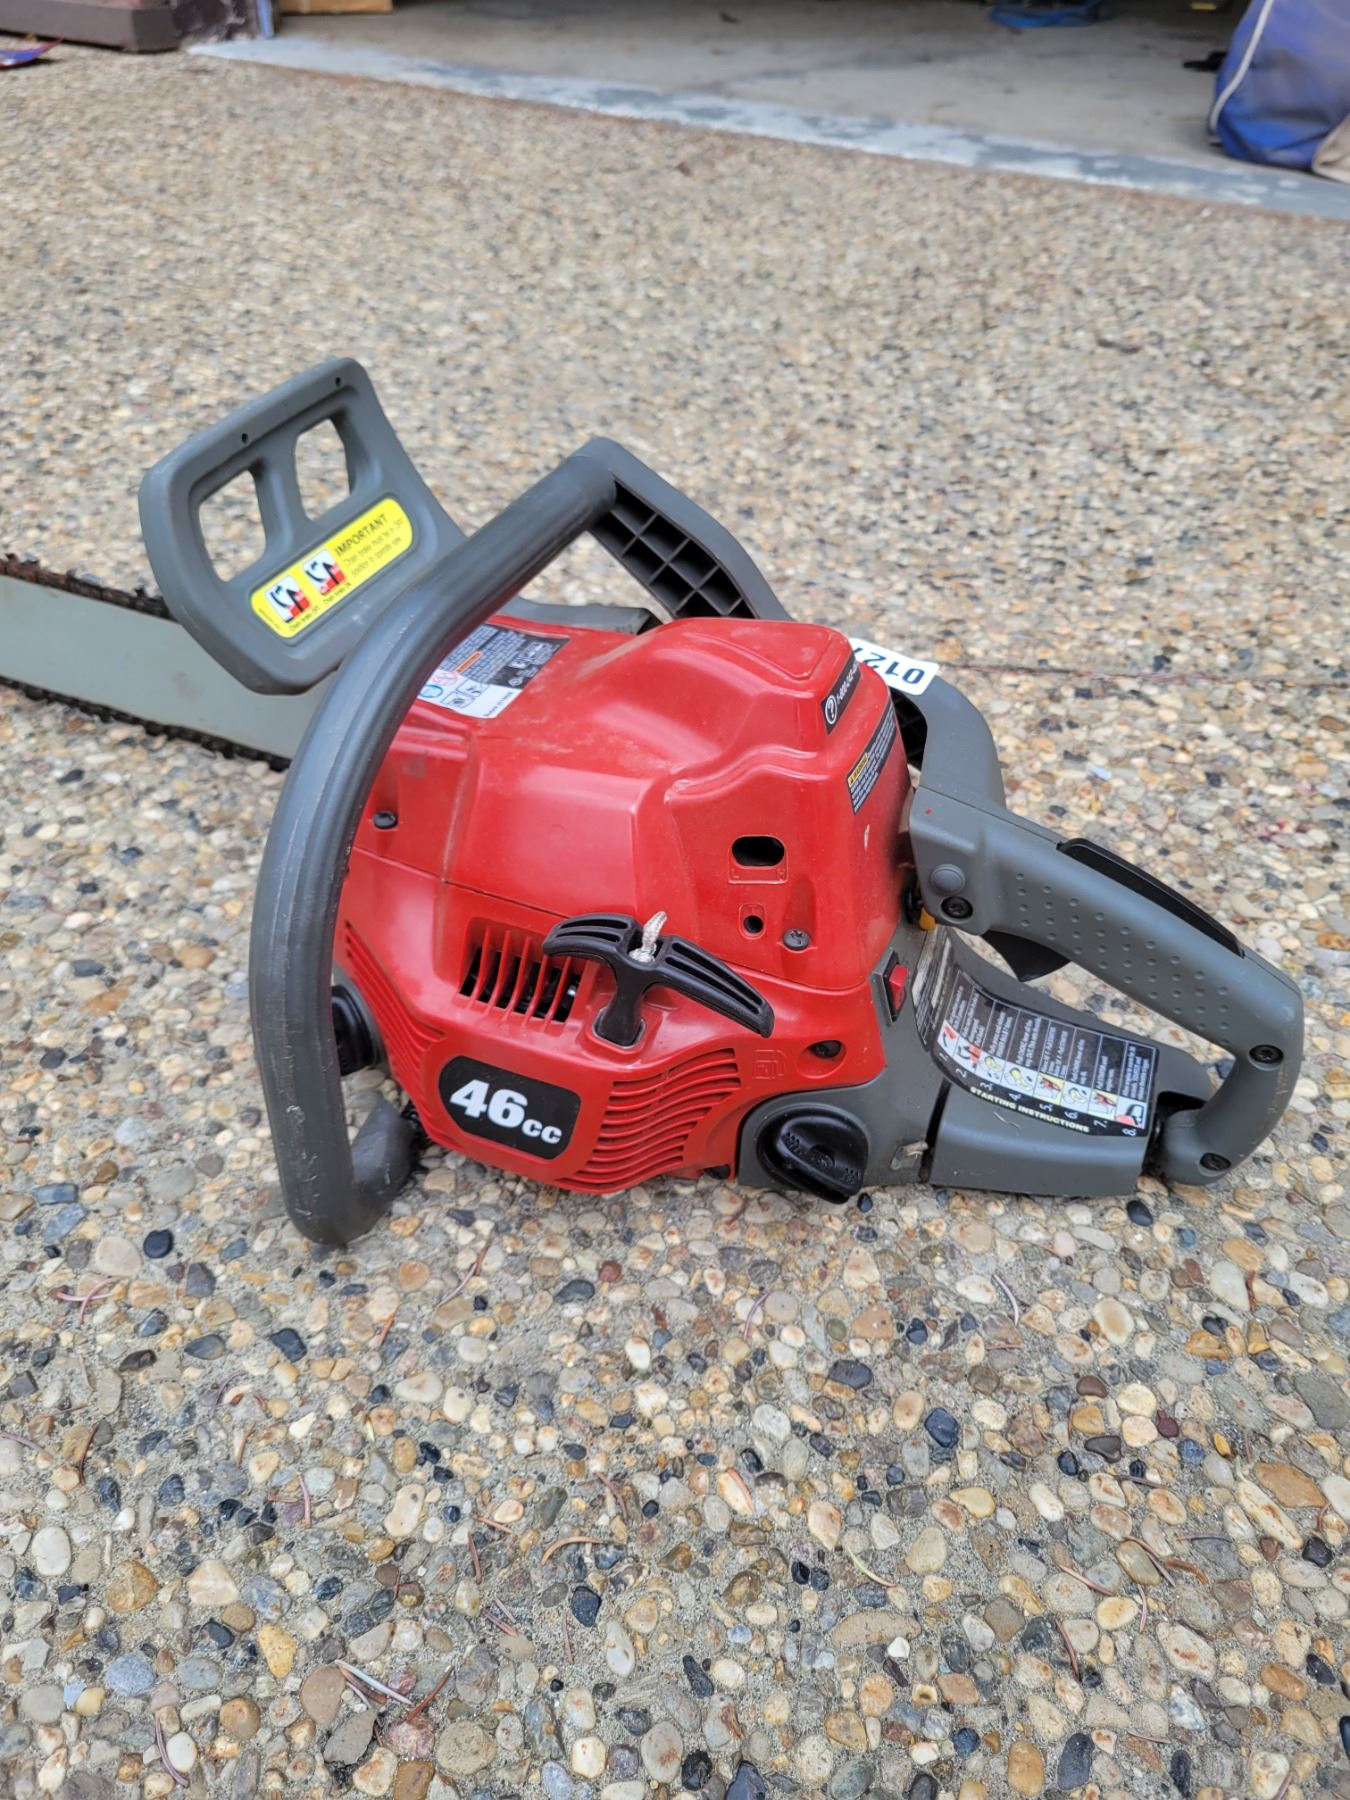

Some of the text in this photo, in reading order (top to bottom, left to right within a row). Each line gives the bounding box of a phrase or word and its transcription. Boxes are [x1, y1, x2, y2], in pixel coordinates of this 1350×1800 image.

[335, 513, 389, 557] IMPORTANT
[979, 1081, 993, 1091] 3.
[1008, 1093, 1022, 1101] 4.
[450, 1079, 562, 1144] 46cc
[970, 1086, 1090, 1133] STARTING INSTRUCTIONS
[1039, 1103, 1053, 1112] 5.
[1064, 1111, 1079, 1119] 6.
[1122, 1128, 1137, 1137] 8.
